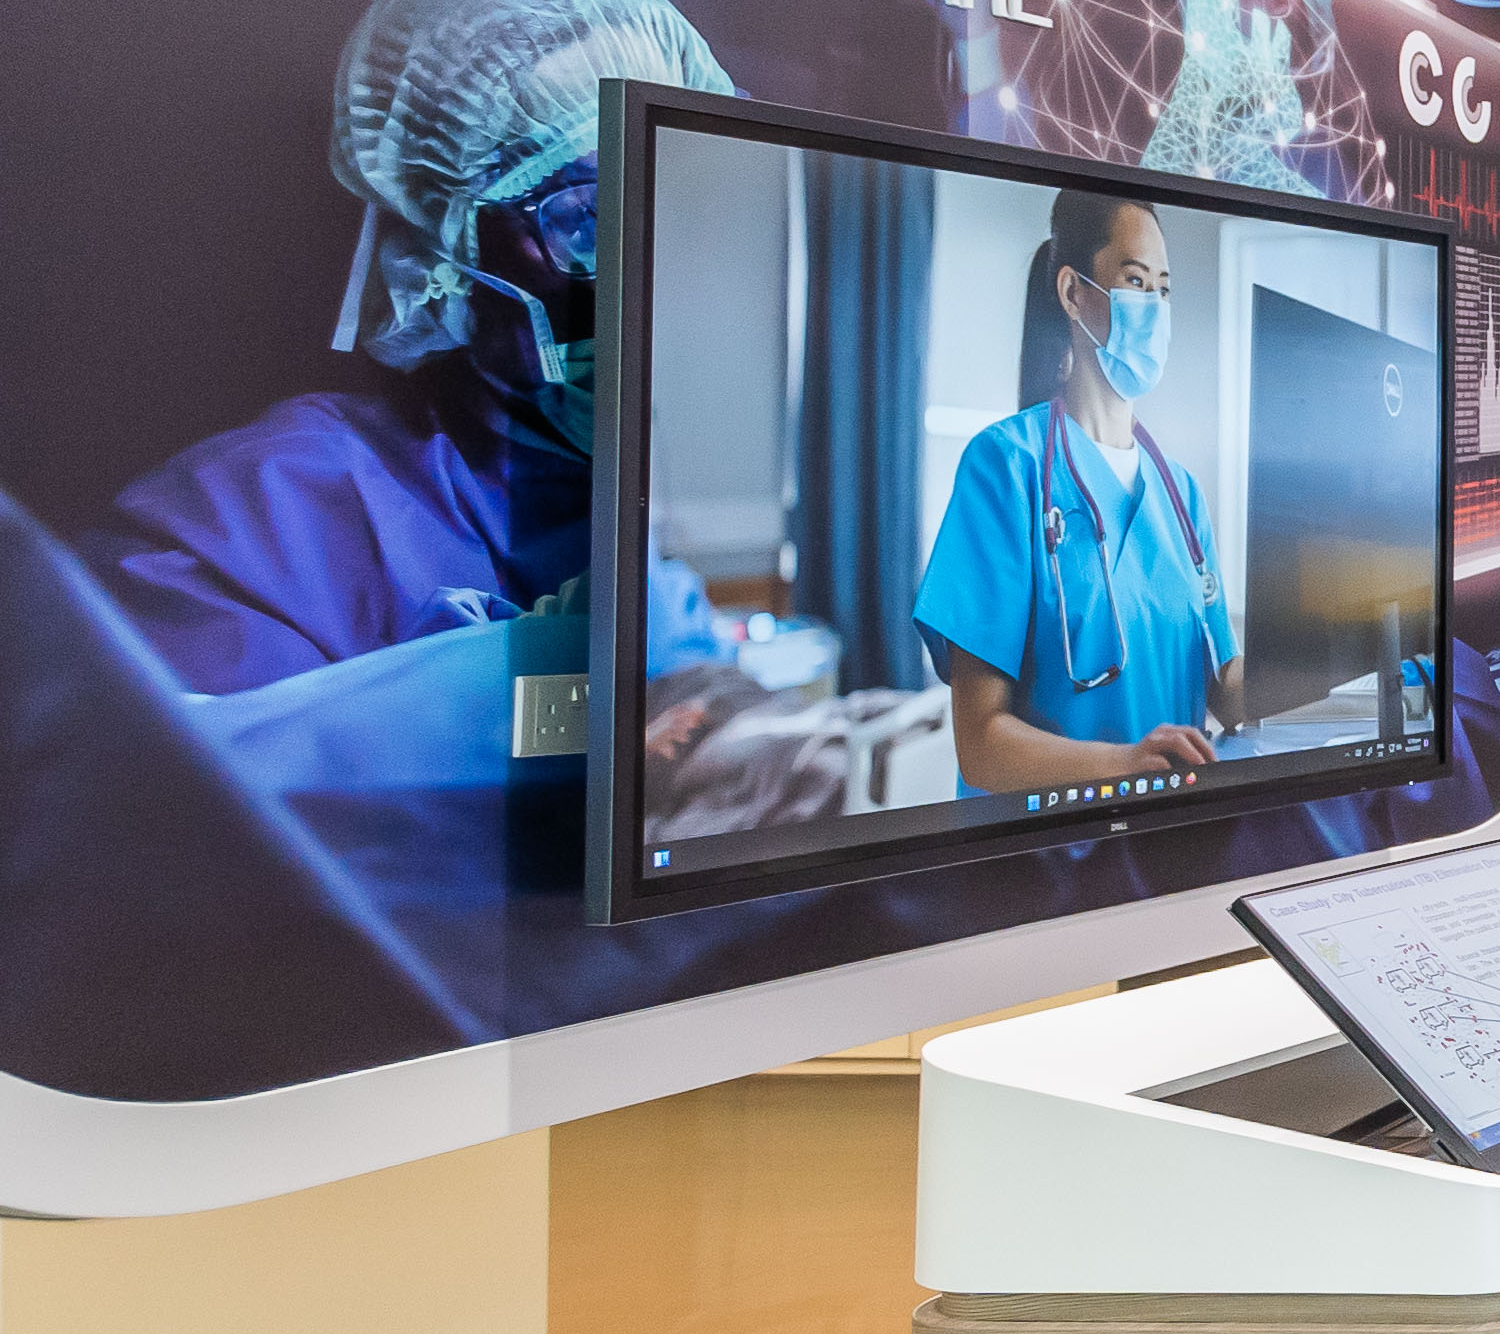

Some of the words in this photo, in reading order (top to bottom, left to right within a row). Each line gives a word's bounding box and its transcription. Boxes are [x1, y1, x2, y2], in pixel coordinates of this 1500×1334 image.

[1110, 821, 1128, 832] DELL
[1267, 903, 1300, 918] Case
[1330, 890, 1359, 905] City
[1351, 877, 1418, 899] Tuberculosis
[1411, 871, 1439, 886] (TB)
